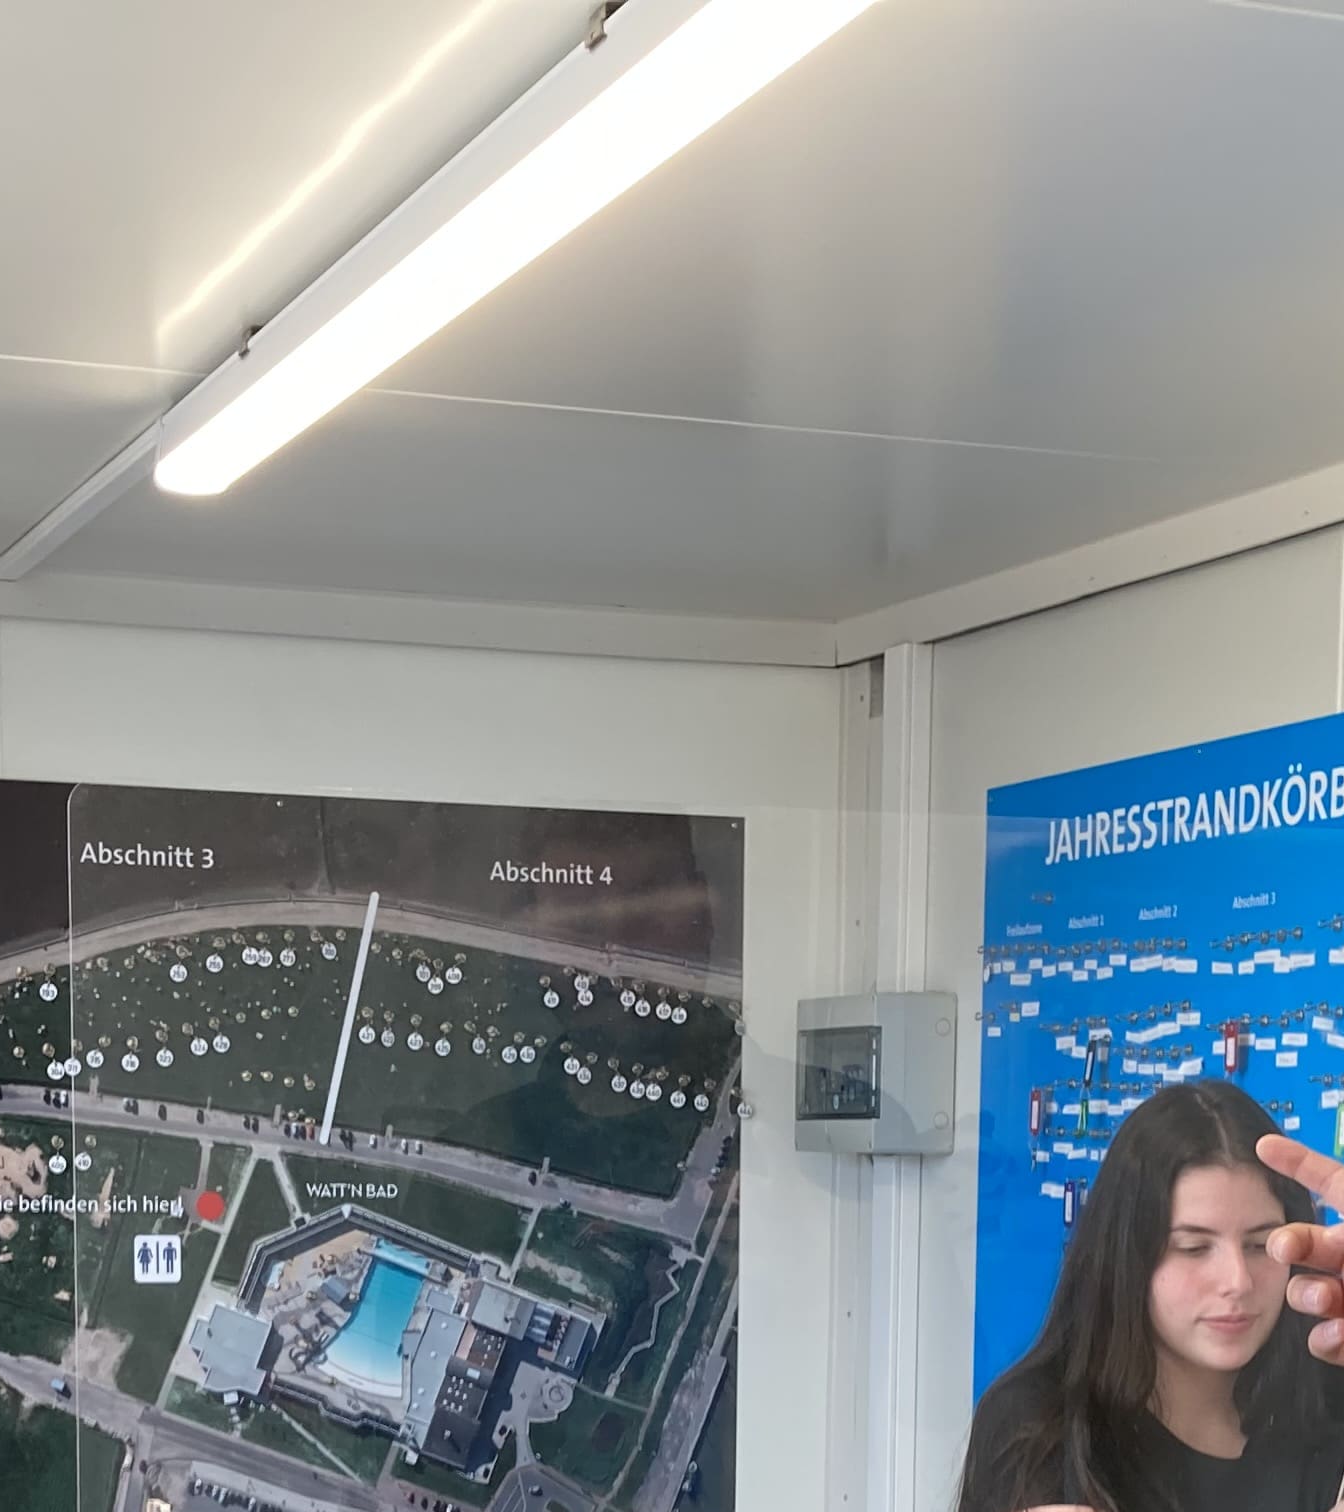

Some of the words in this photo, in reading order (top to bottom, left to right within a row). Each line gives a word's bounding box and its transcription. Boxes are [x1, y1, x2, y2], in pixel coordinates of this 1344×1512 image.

[80, 841, 194, 868] Abschnitt
[201, 848, 214, 869] 3
[490, 860, 594, 885] Abschnitt
[599, 866, 613, 885] 4
[366, 1183, 398, 1198] BAD
[18, 1194, 99, 1213] befinden
[103, 1195, 137, 1213] sich
